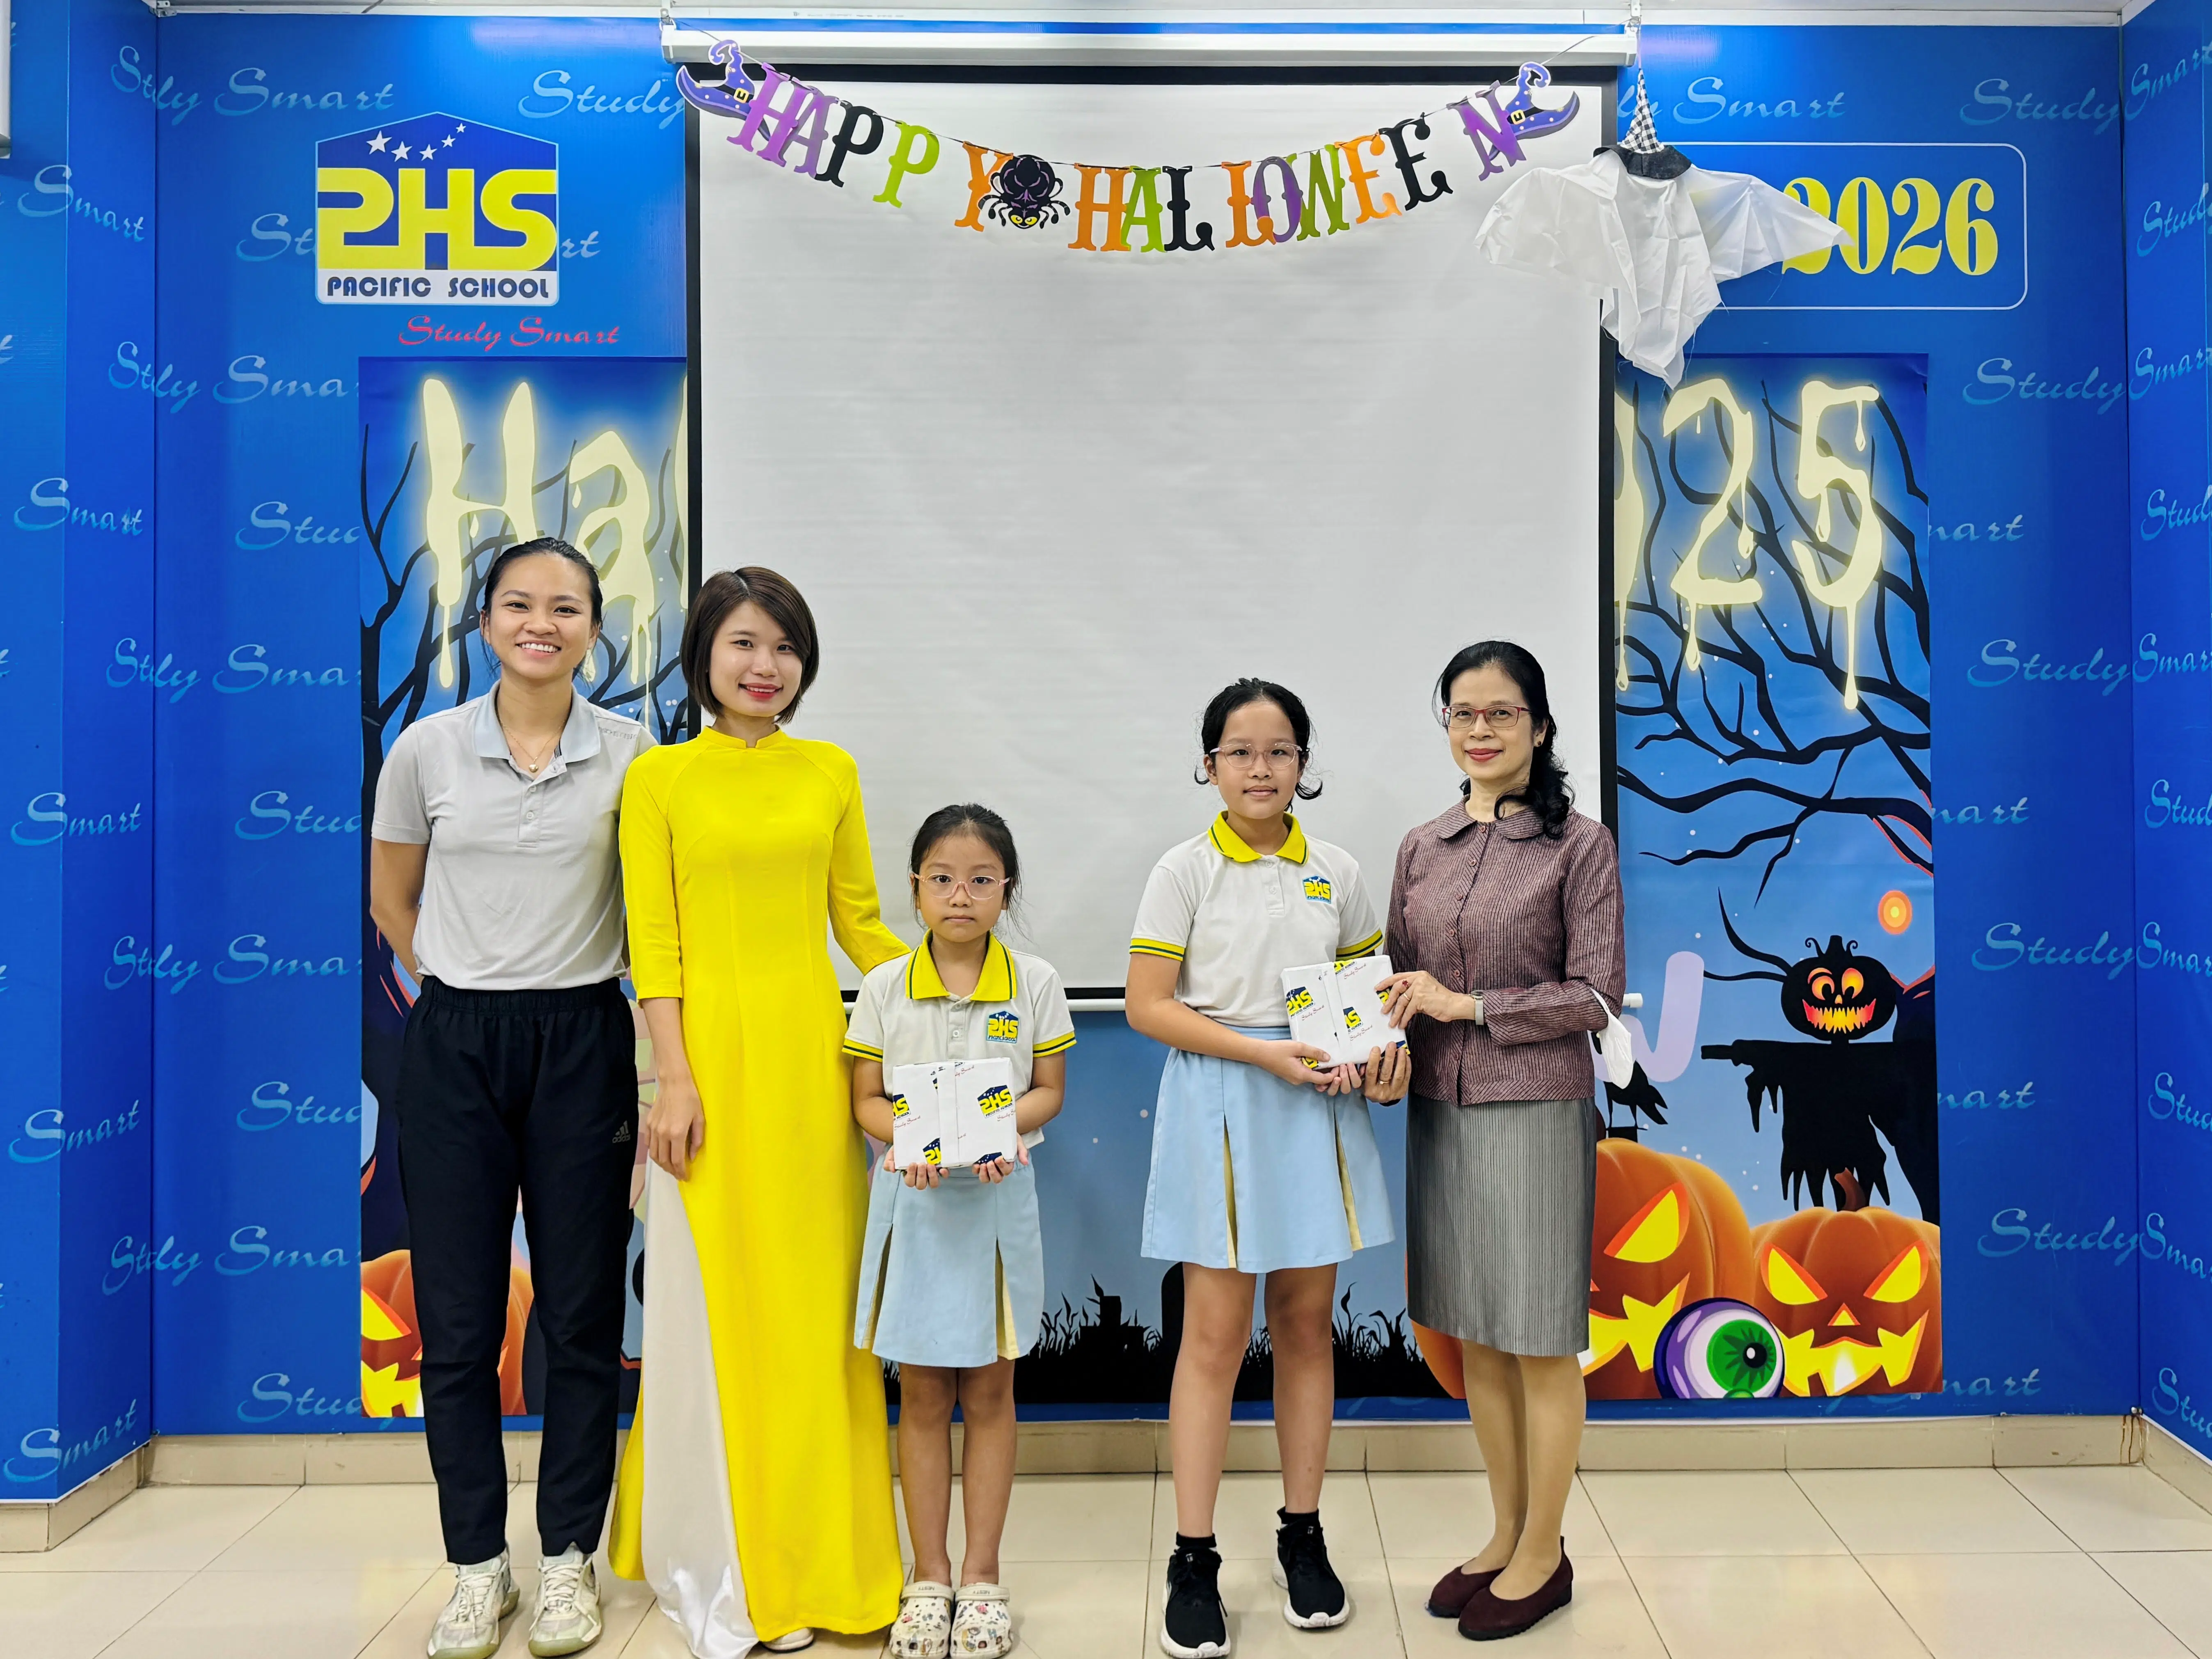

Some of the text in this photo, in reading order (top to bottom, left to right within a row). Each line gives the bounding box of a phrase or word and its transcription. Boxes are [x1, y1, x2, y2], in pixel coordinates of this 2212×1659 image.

[215, 68, 394, 117] Smart
[518, 69, 684, 129] Study
[1673, 77, 1845, 124] Smart
[1960, 79, 2118, 133] Study
[726, 62, 1013, 232] HAPPY
[18, 165, 144, 241] Smart
[327, 277, 549, 298] PACIFIC SCHOOL
[399, 315, 620, 352] Study Smart
[1963, 358, 2125, 414] Study
[14, 478, 142, 535] Smart
[1967, 639, 2132, 697] Study
[11, 792, 141, 846] Smart
[1972, 923, 2135, 980] Study
[8, 1100, 139, 1164] Smart
[1978, 1208, 2137, 1265] Study
[3, 1399, 137, 1482] Smart
